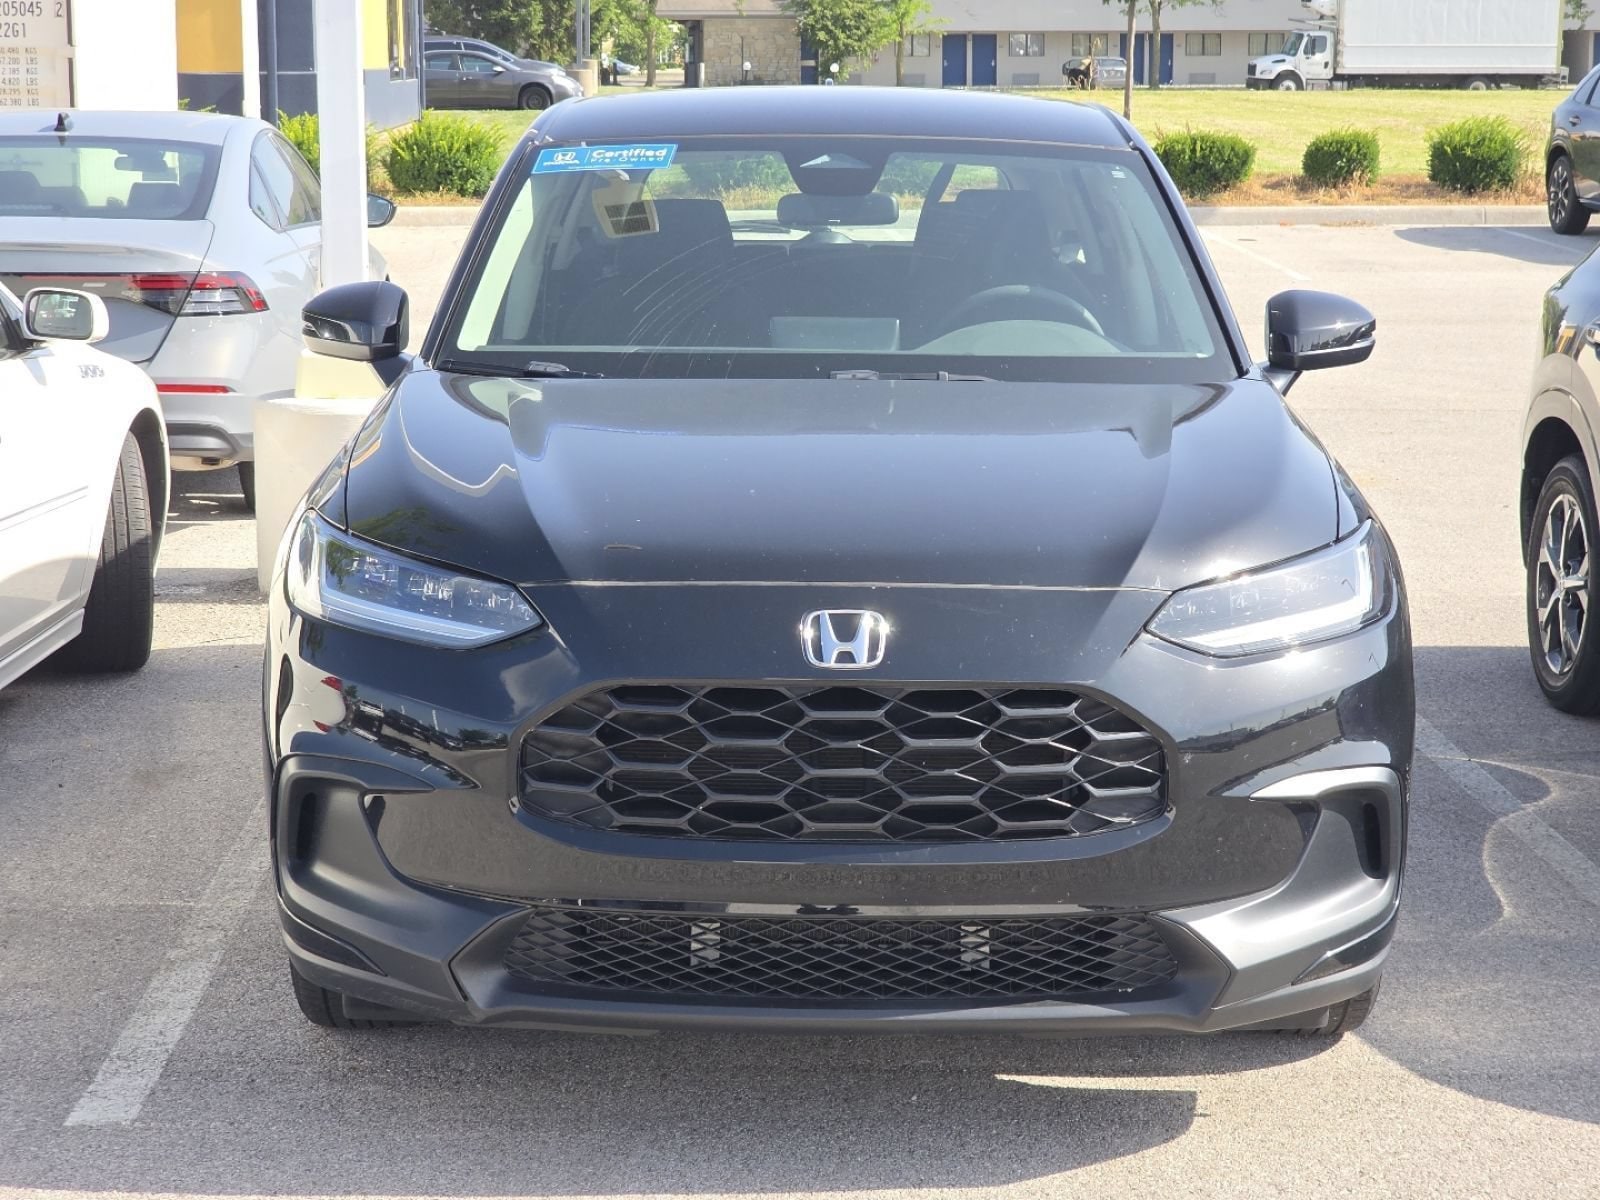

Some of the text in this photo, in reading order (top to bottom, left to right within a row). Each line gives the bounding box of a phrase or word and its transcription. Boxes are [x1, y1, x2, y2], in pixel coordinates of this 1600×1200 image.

[0, 1, 63, 18] 05045 2
[592, 148, 668, 159] Certified
